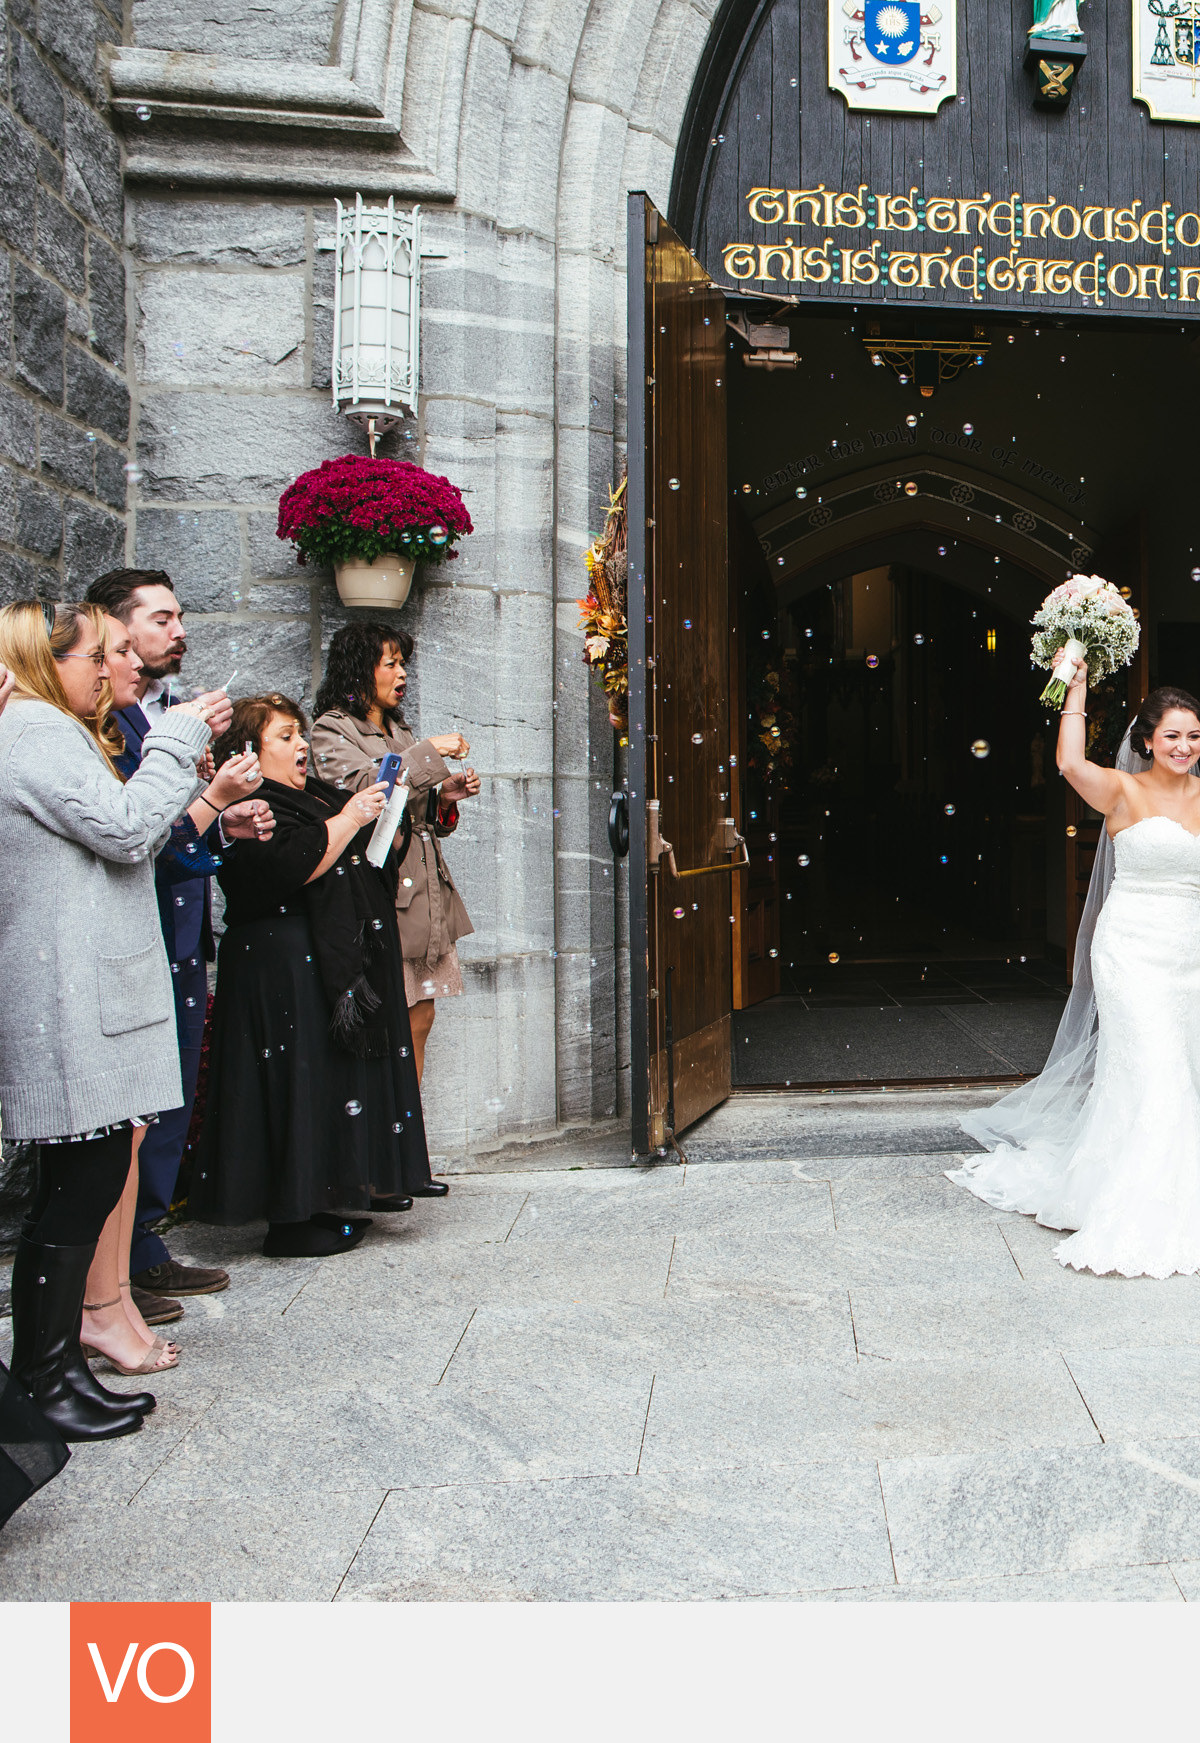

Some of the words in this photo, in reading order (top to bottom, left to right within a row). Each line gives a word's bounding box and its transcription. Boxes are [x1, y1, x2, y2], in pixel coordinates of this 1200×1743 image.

[746, 183, 868, 228] THIS
[876, 186, 919, 231] IS
[925, 192, 1021, 247] THE
[1022, 195, 1171, 256] HOUSE
[721, 237, 833, 283] THIS
[840, 239, 881, 285] IS
[888, 246, 983, 300] THE
[986, 247, 1104, 307] GATE
